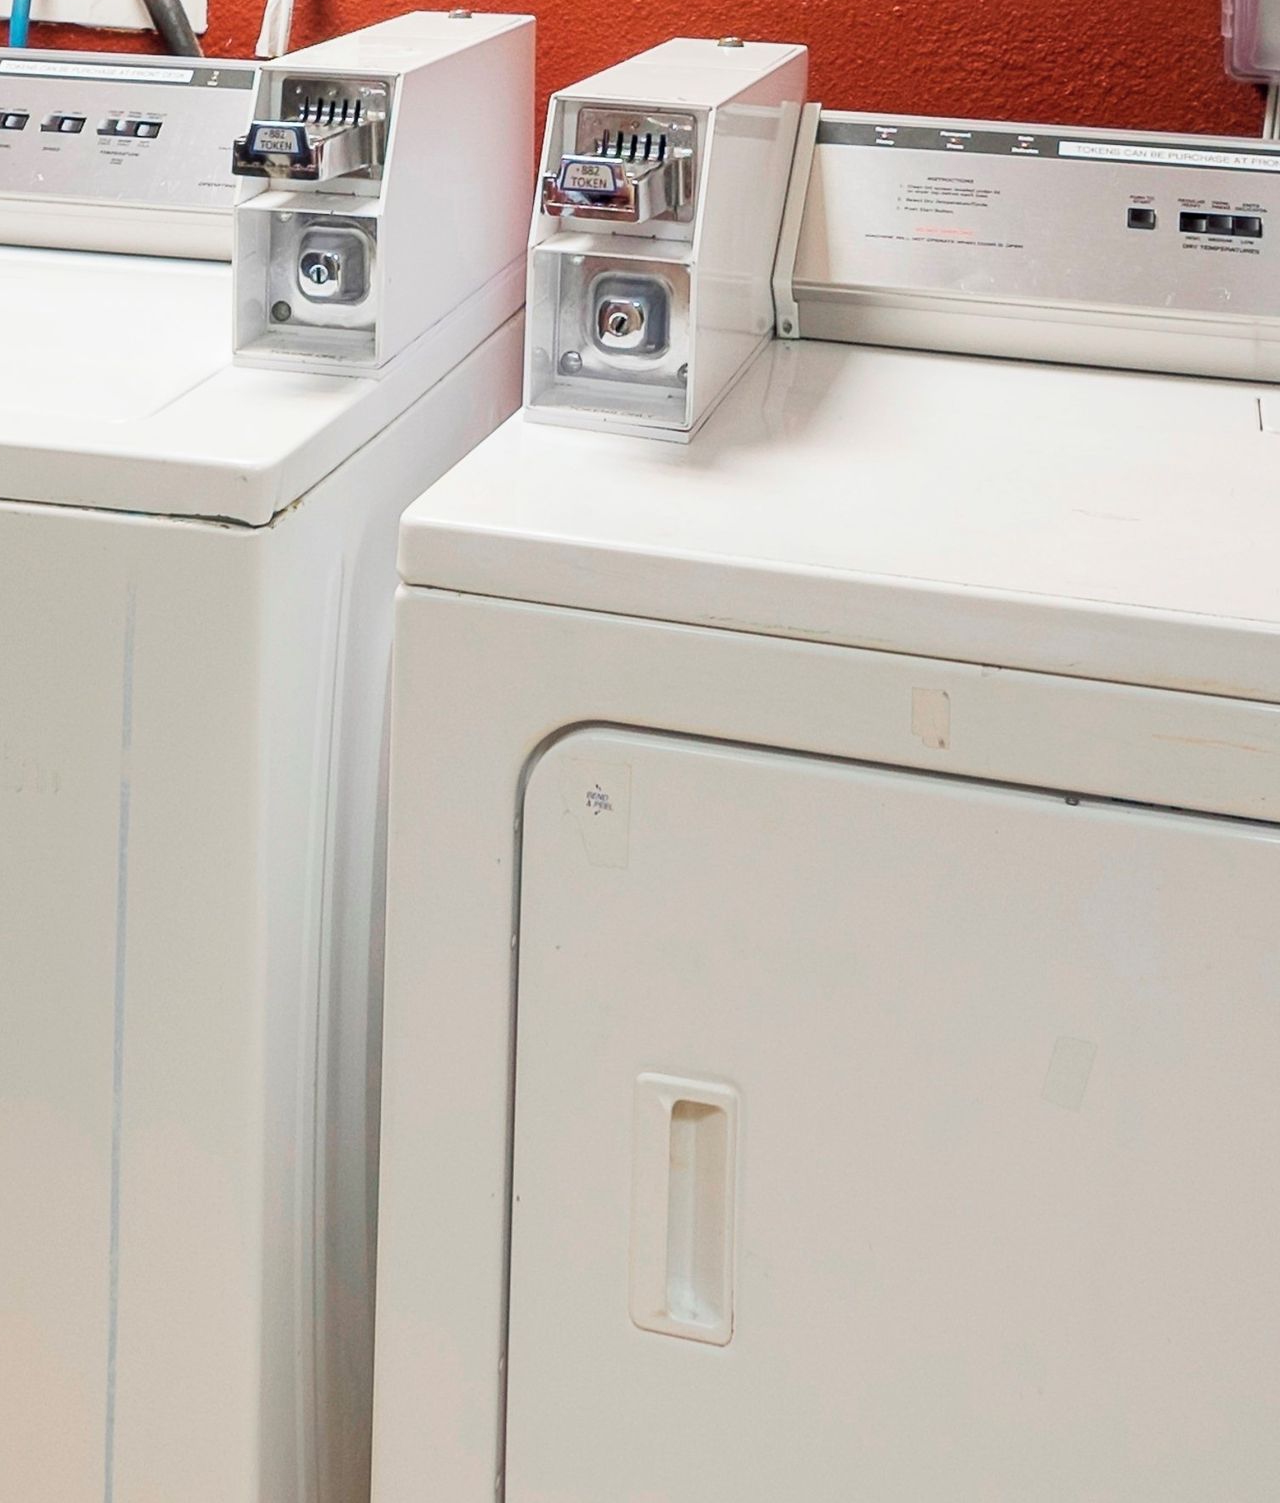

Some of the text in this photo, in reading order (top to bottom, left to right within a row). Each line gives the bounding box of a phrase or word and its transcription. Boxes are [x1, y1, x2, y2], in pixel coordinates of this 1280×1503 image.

[260, 140, 293, 151] TOKEN
[1076, 145, 1121, 156] TOKENS
[1123, 148, 1147, 158] CAN
[1150, 150, 1165, 159] BE
[1168, 152, 1231, 164] PURCHASE
[1233, 157, 1248, 165] AT
[570, 177, 608, 188] TOKEN
